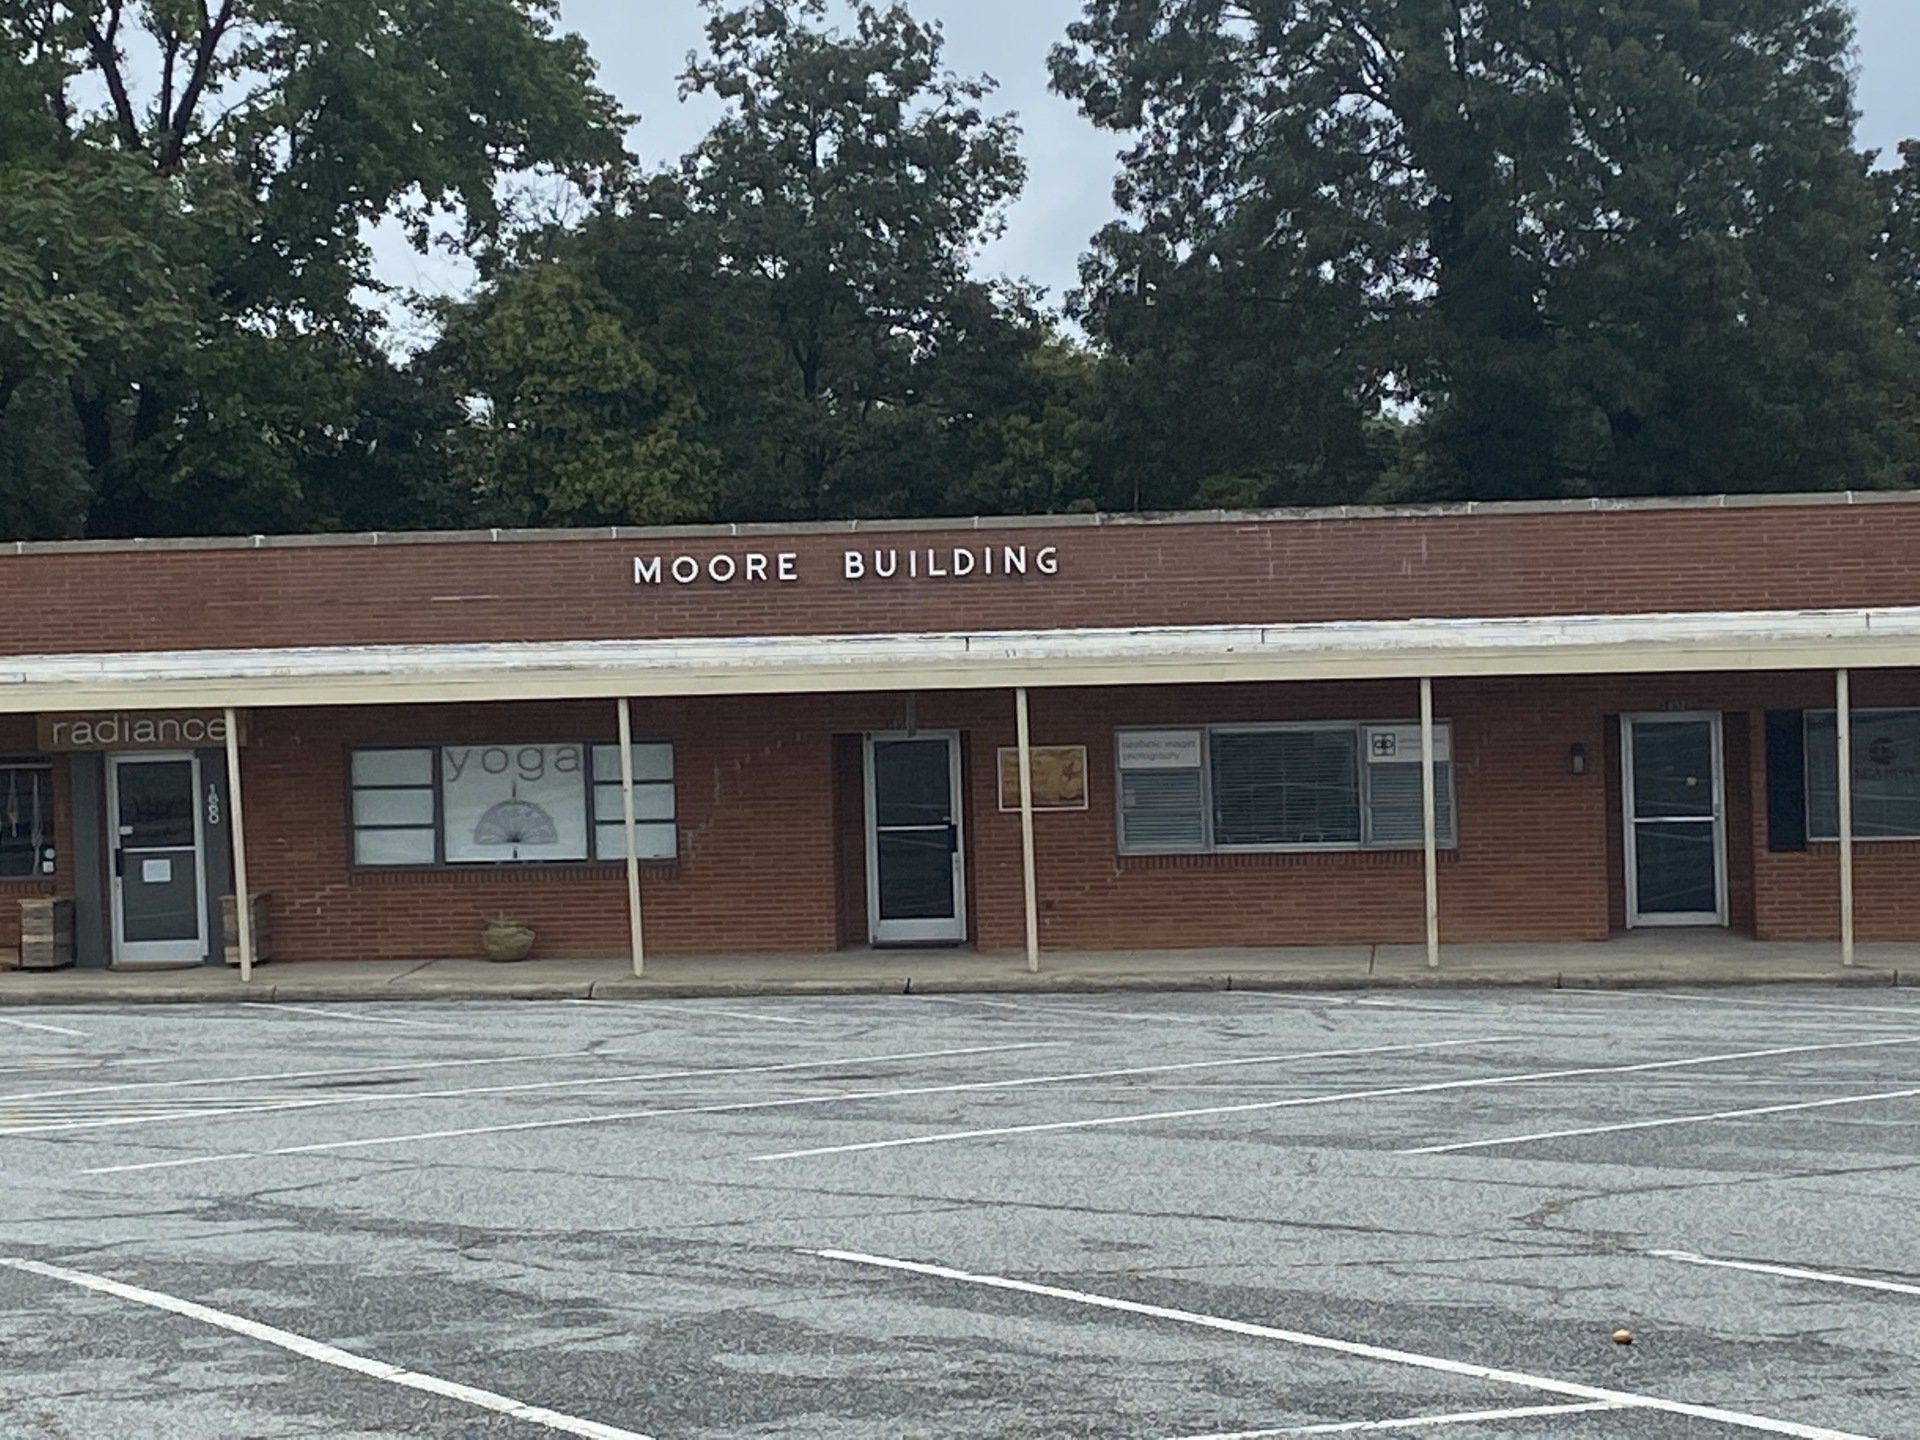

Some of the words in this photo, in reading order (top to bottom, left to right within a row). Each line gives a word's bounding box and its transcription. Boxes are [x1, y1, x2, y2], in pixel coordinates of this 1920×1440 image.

[633, 552, 798, 585] MOORE
[844, 545, 1058, 579] BUILDING
[52, 713, 227, 745] radiance
[443, 746, 581, 783] yoga
